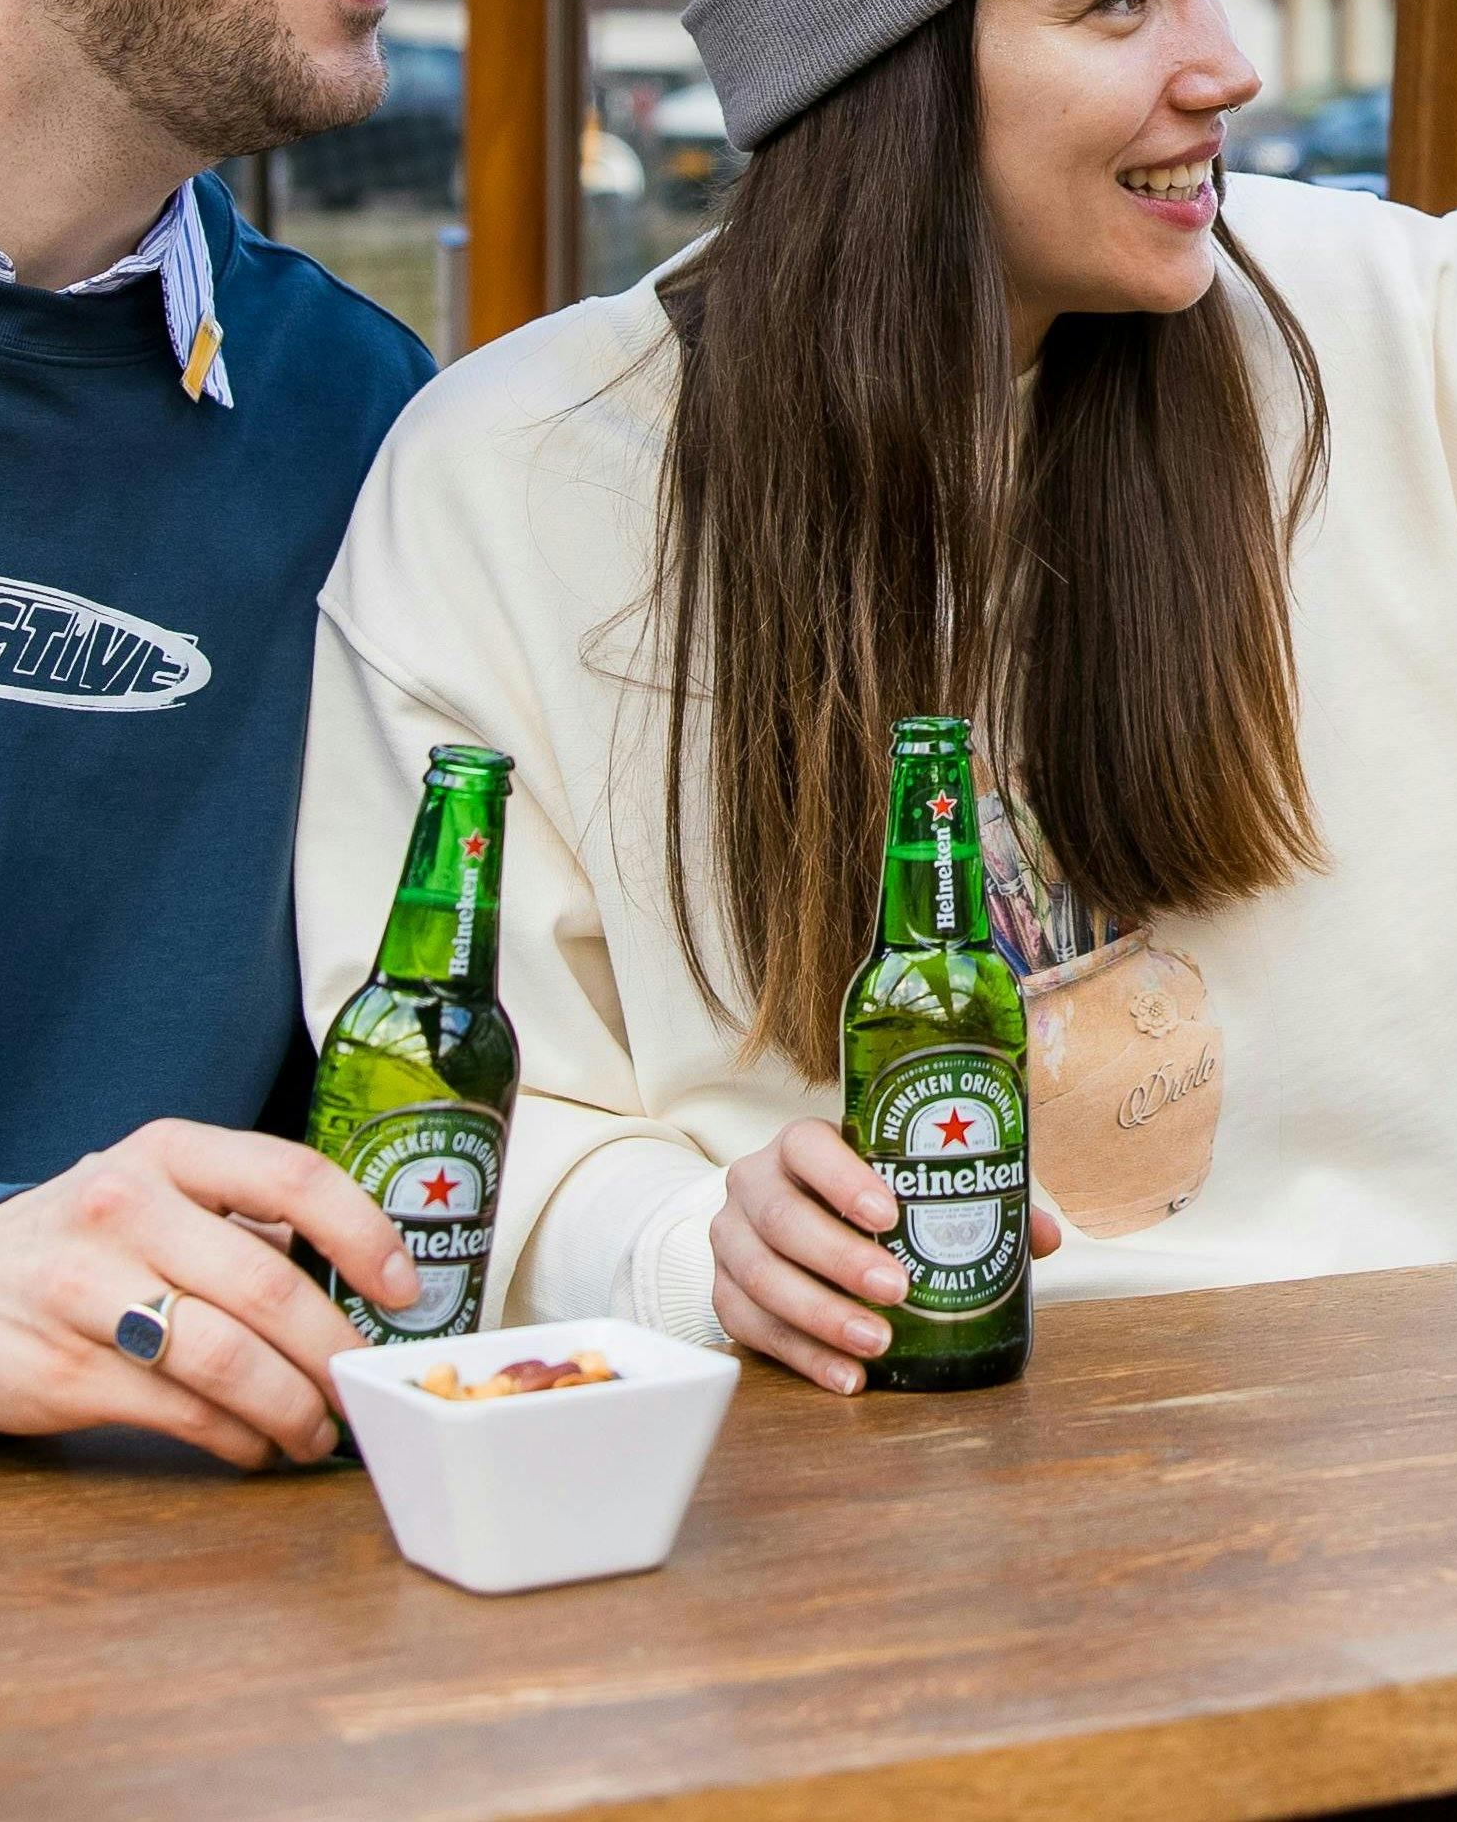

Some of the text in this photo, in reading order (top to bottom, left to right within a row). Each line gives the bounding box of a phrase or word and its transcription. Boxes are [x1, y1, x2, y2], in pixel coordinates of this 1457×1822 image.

[934, 826, 956, 930] Heineken
[448, 868, 479, 977] Heineken
[881, 1072, 953, 1141] HEINEKEN
[959, 1072, 1018, 1133] ORIGINAL
[360, 1130, 499, 1197] HEINEKEN ORIGINAL
[928, 1268, 977, 1291] MALT
[982, 1229, 1017, 1283] LAGER
